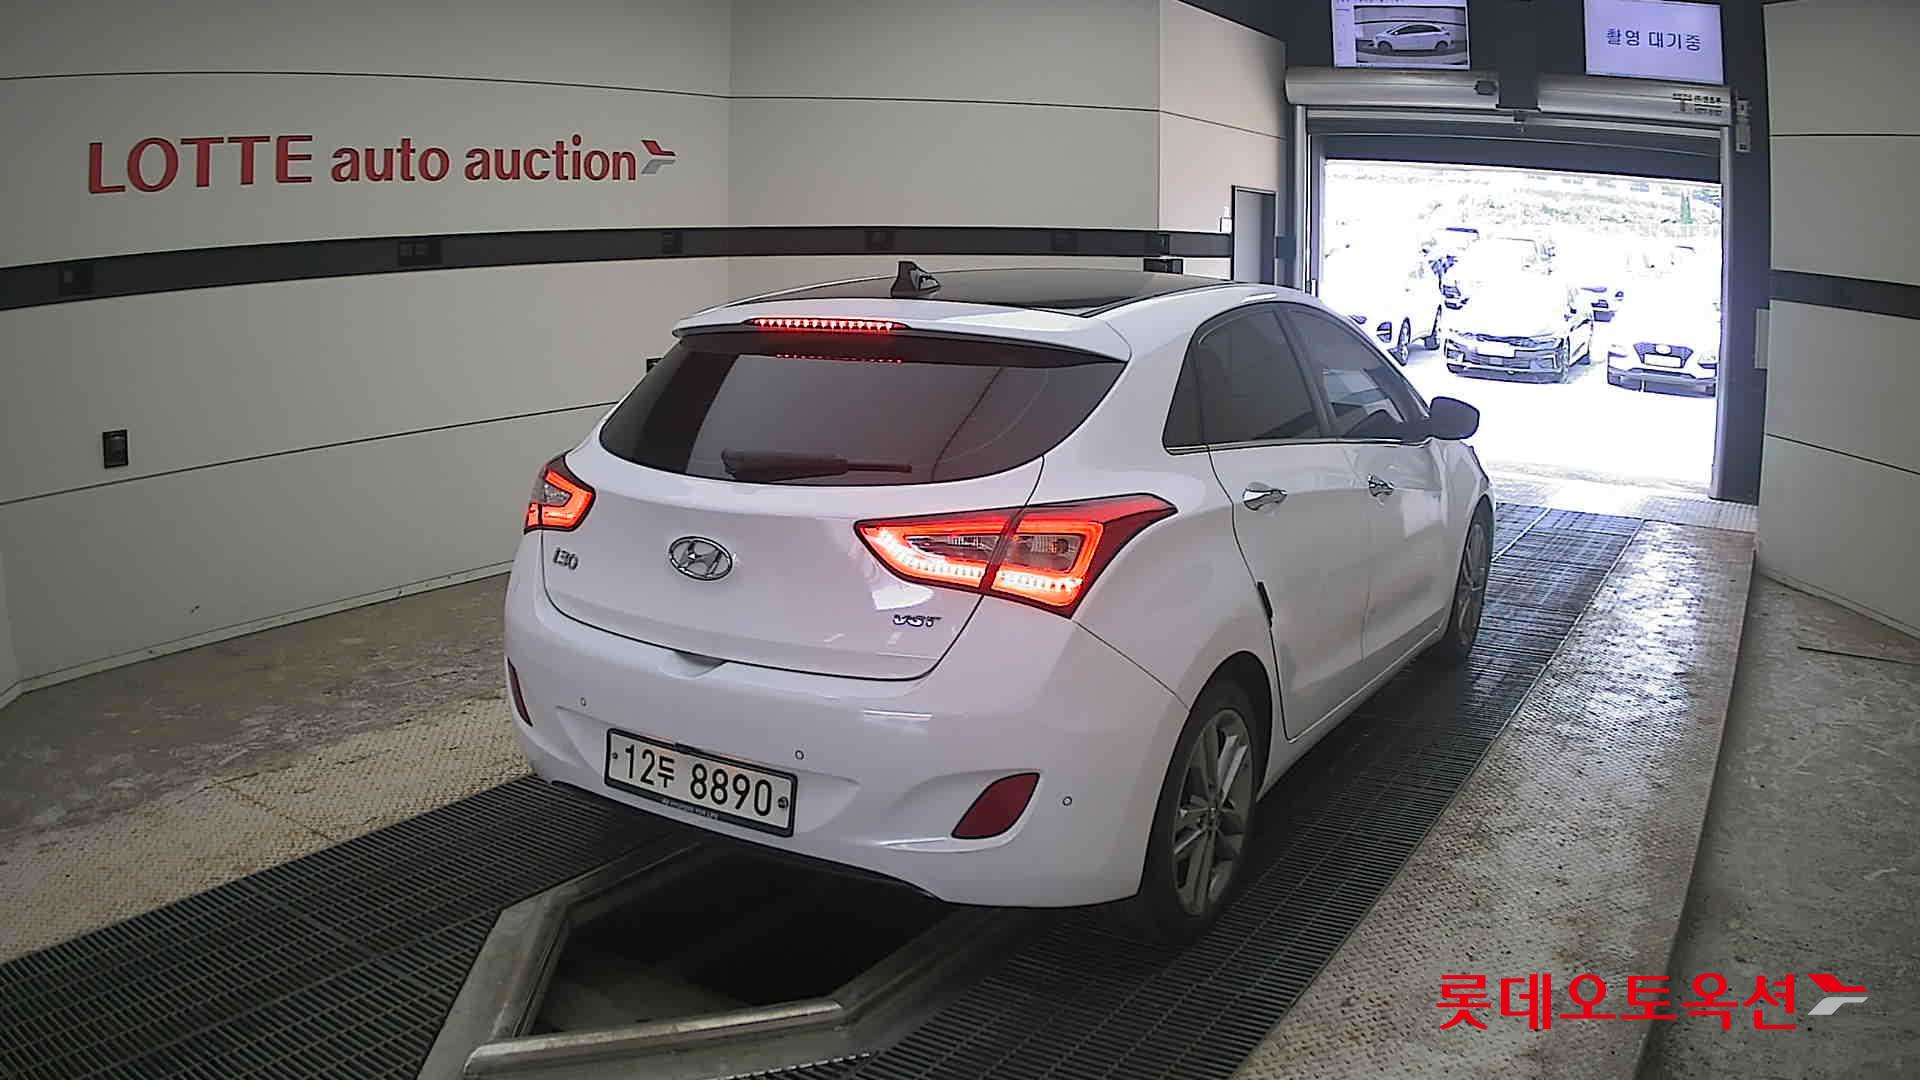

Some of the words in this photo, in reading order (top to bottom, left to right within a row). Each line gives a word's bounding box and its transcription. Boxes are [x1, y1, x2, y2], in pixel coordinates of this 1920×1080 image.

[1607, 27, 1640, 47] 촬영
[1648, 31, 1701, 52] 대기중
[88, 134, 313, 195] LOTTE
[330, 137, 450, 183] auto
[464, 134, 638, 182] auction
[625, 744, 675, 789] 12두
[690, 763, 772, 816] 8890
